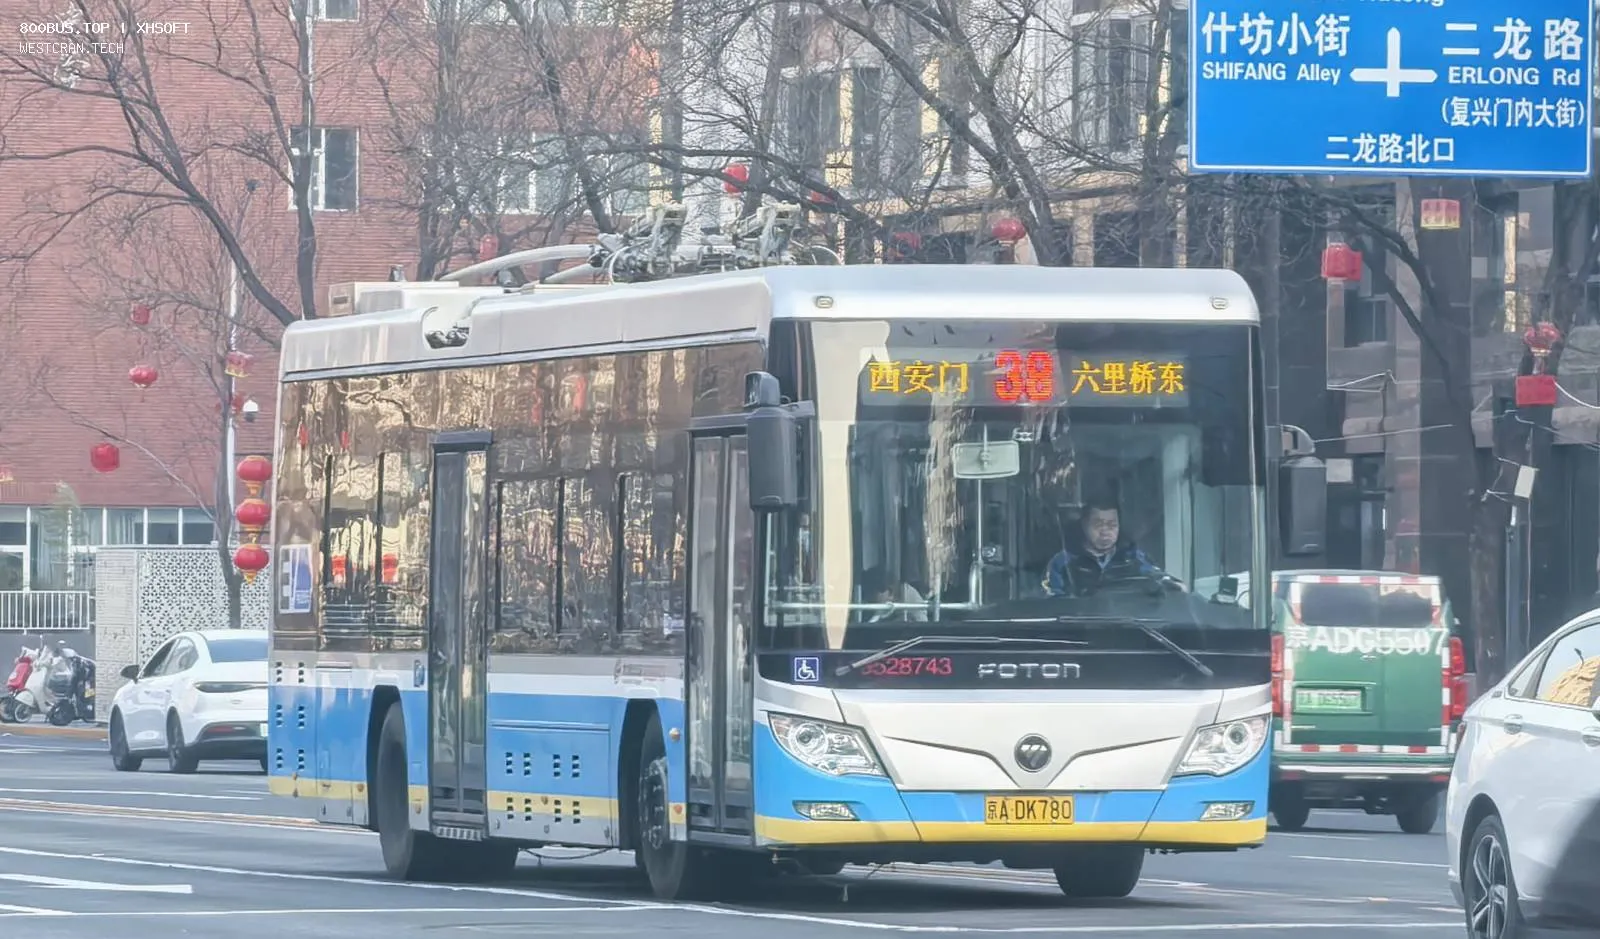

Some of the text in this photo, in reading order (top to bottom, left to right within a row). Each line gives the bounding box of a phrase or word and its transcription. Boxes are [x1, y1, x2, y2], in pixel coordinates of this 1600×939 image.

[1201, 11, 1351, 57] 什坊小街
[1442, 17, 1584, 62] 二龙路
[1202, 62, 1341, 85] SHIFANG Alley
[1448, 66, 1580, 86] ERLONG Rd
[1441, 96, 1585, 128] (复兴门内大街)
[1325, 134, 1455, 164] 二龙路北口
[867, 349, 1185, 402] 西安门 38 六里桥东
[977, 662, 1081, 679] FOTON
